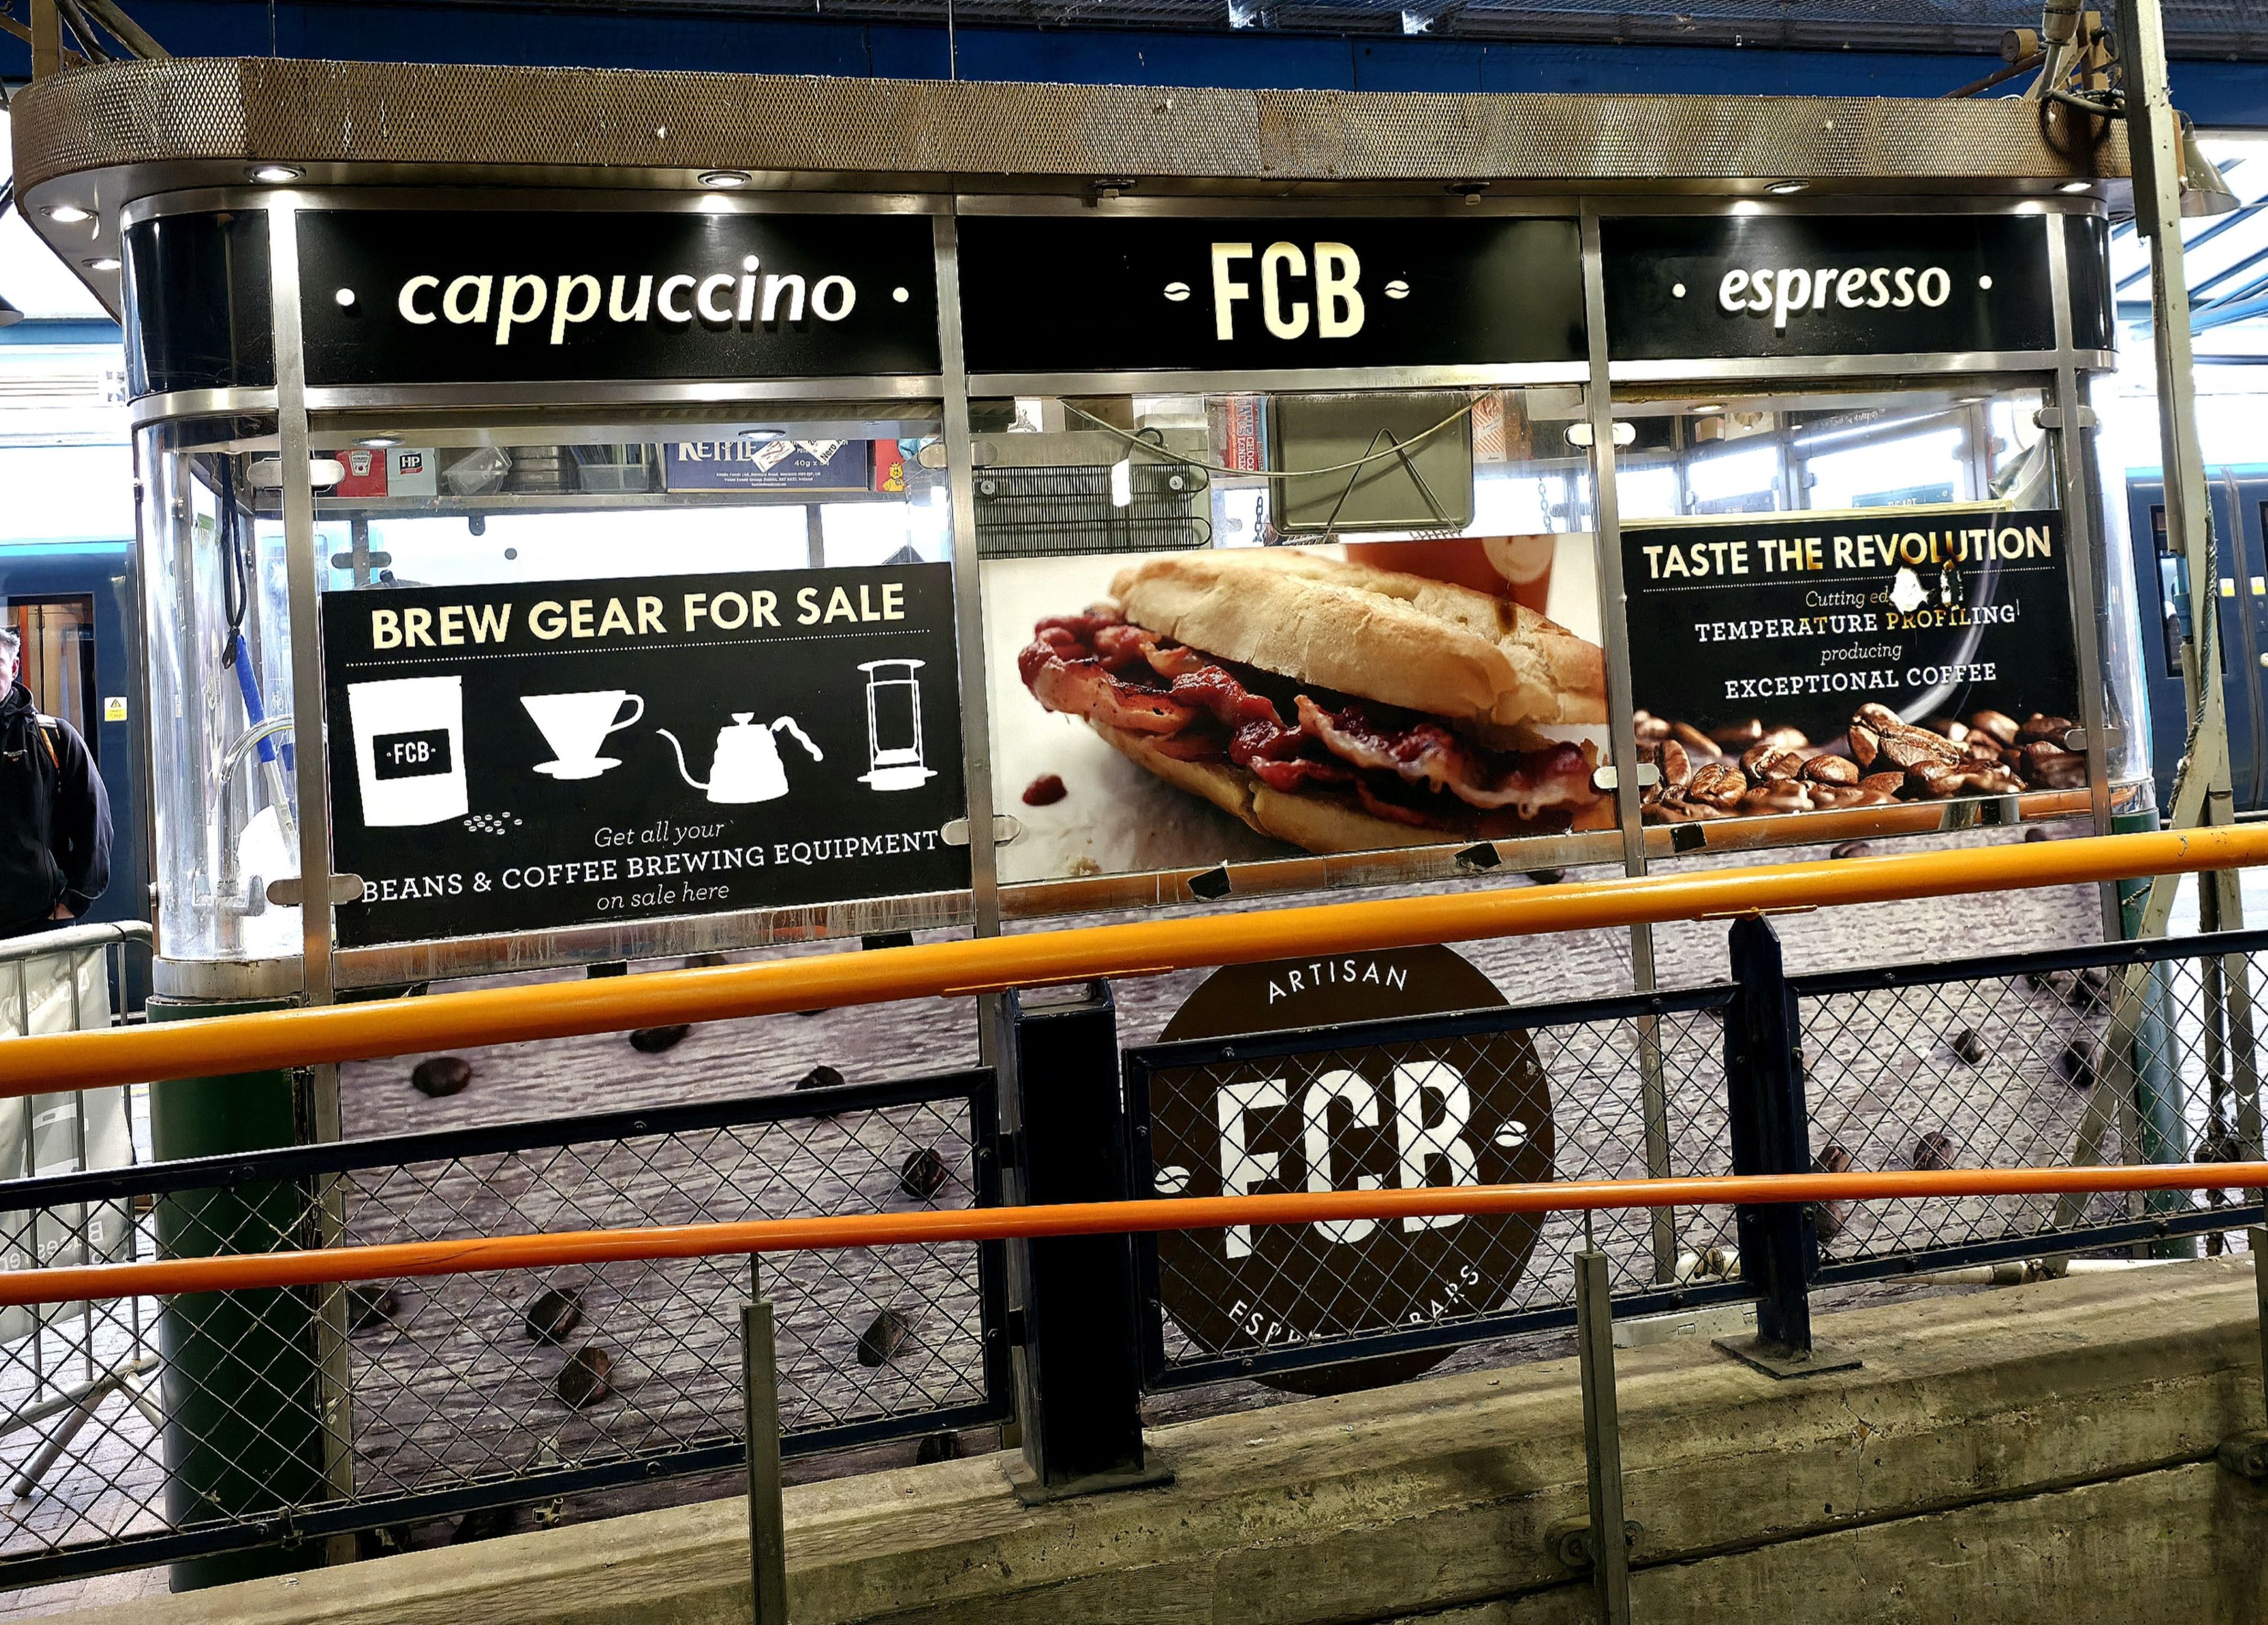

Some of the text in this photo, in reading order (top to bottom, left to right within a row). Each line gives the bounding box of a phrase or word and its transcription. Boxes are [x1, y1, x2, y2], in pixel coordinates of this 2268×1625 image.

[398, 254, 856, 345] cappuccino
[1211, 242, 1365, 340] FCB
[1719, 267, 1951, 328] espresso
[401, 456, 420, 467] HP
[820, 444, 837, 461] Nero
[1642, 525, 2051, 579] TASTE THE REVOLUTION
[372, 583, 905, 650] BREW GEAR FOR SALE
[1806, 590, 1865, 609] Cutting
[1695, 605, 2015, 642] TEMPERATURE PROFILING
[1820, 641, 1902, 666] producing
[1724, 663, 1996, 699] EXCEPTIONAL COFFEE
[394, 741, 429, 764] FCB
[594, 820, 725, 847] Get all your
[362, 830, 938, 903] BEANS & COFFEE BREWING EQUIPMENT
[597, 881, 729, 911] on sale here
[1269, 960, 1407, 1005] ARTISAN
[1216, 1060, 1479, 1259] FCB
